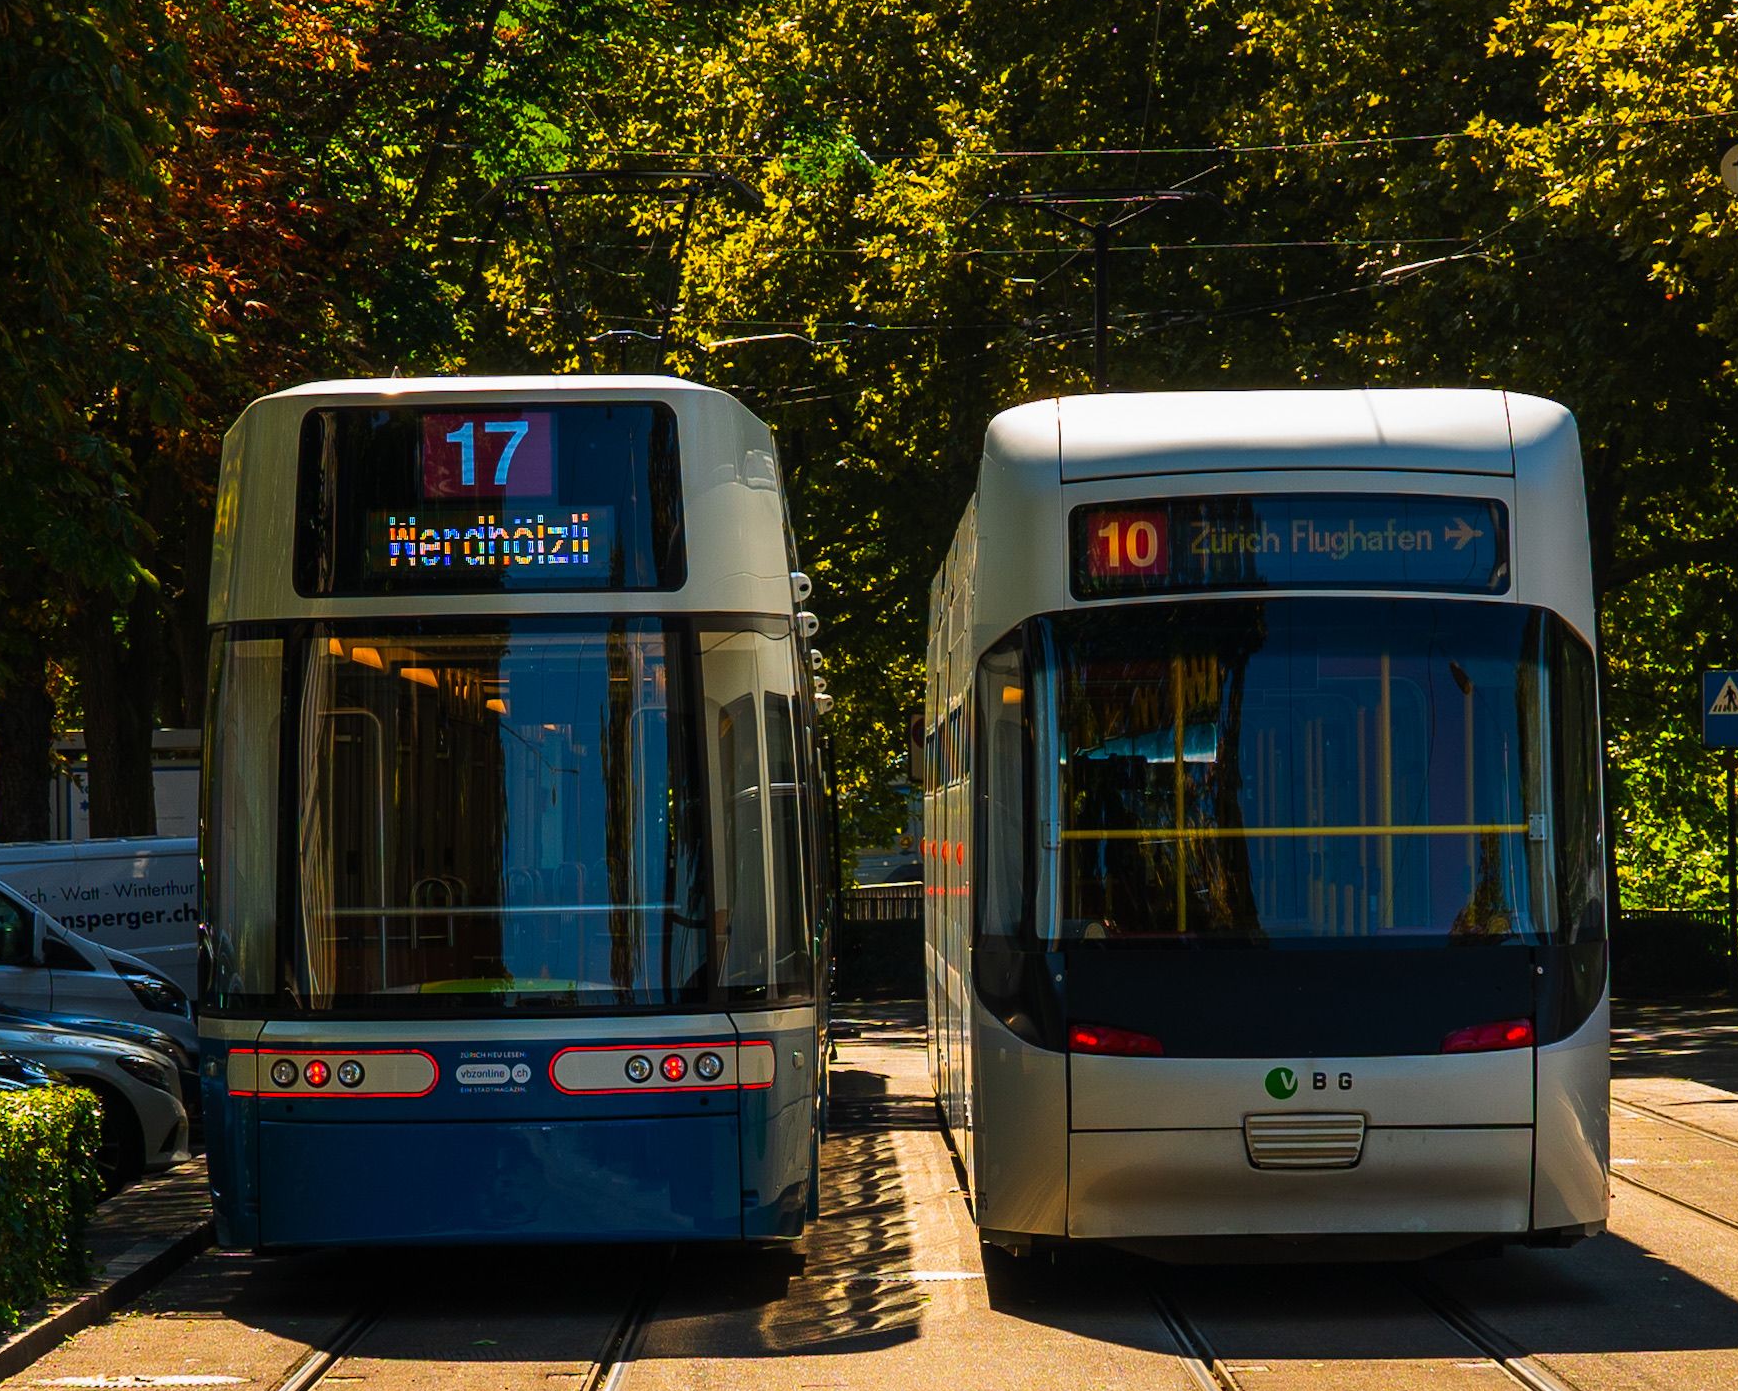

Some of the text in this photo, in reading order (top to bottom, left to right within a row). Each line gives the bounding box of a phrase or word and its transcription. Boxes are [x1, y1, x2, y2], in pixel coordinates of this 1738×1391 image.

[446, 420, 529, 486] 17
[389, 513, 590, 567] Werdhölzli
[1098, 520, 1158, 567] 10
[1190, 518, 1433, 560] Zürich Flughafen
[61, 886, 100, 902] Watt
[113, 880, 196, 899] Winterthur
[460, 1069, 506, 1079] vbzonline
